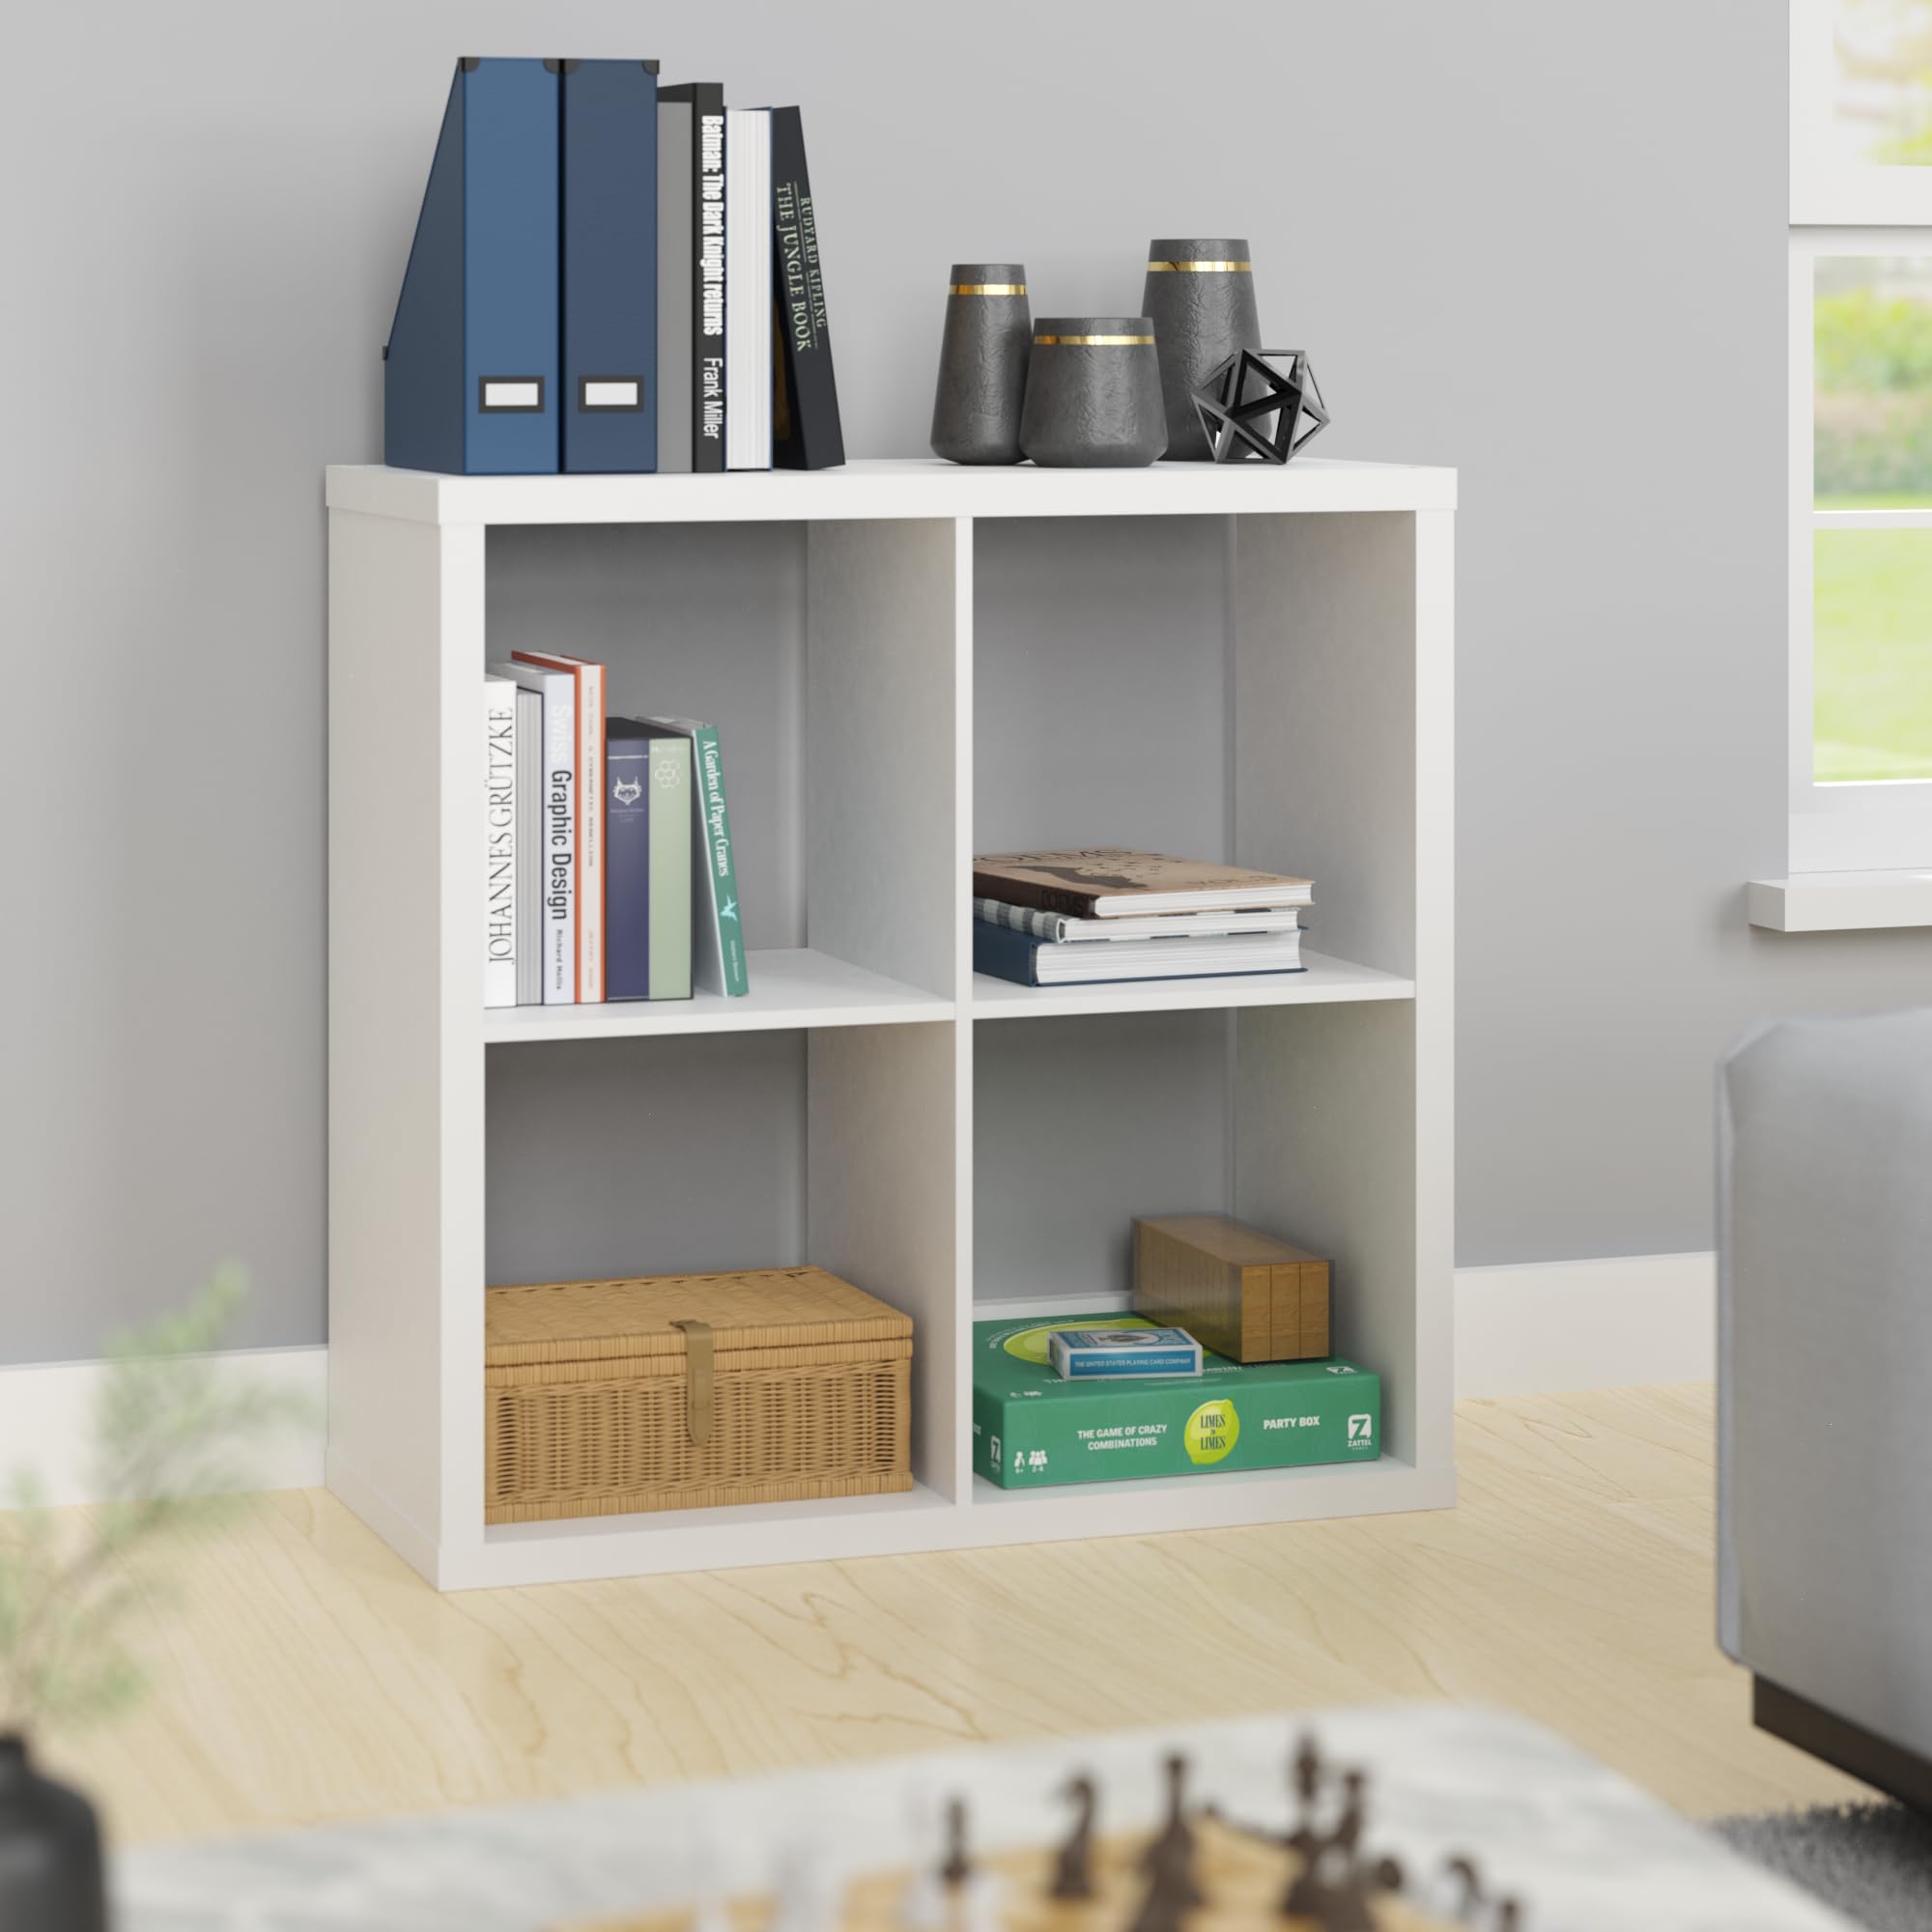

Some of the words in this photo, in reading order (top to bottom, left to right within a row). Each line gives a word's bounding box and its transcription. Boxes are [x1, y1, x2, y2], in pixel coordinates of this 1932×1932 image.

[701, 115, 724, 173] Batman:
[702, 174, 724, 200] The
[776, 182, 795, 221] THE
[702, 201, 724, 236] Dark
[800, 196, 819, 264] RUDYARD
[699, 236, 724, 282] Knight
[776, 224, 805, 298] JUNGLE
[703, 283, 724, 335] returns
[809, 269, 827, 328] KIPLING
[790, 300, 812, 353] BOOK
[703, 357, 723, 397] Frank
[702, 400, 723, 440] Miller
[550, 704, 572, 763] Swiss
[702, 740, 718, 751] A
[484, 708, 513, 827] GRÜTZKE
[703, 750, 722, 790] Garden
[547, 770, 572, 846] Graphic
[708, 791, 724, 804] of
[707, 805, 725, 837] Paper
[715, 838, 730, 877] Cranes
[487, 833, 514, 965] JOHANNES
[547, 853, 572, 921] Design
[1077, 1430, 1095, 1439] THE
[1096, 1427, 1123, 1437] GAME
[1124, 1426, 1137, 1435] OF
[1138, 1424, 1168, 1435] CRAZY
[1200, 1413, 1227, 1429] LIMES
[1263, 1417, 1298, 1430] PARTY
[1299, 1416, 1321, 1427] BOX
[1088, 1436, 1158, 1451] COMBINATIONS
[1200, 1436, 1227, 1451] LIMES
